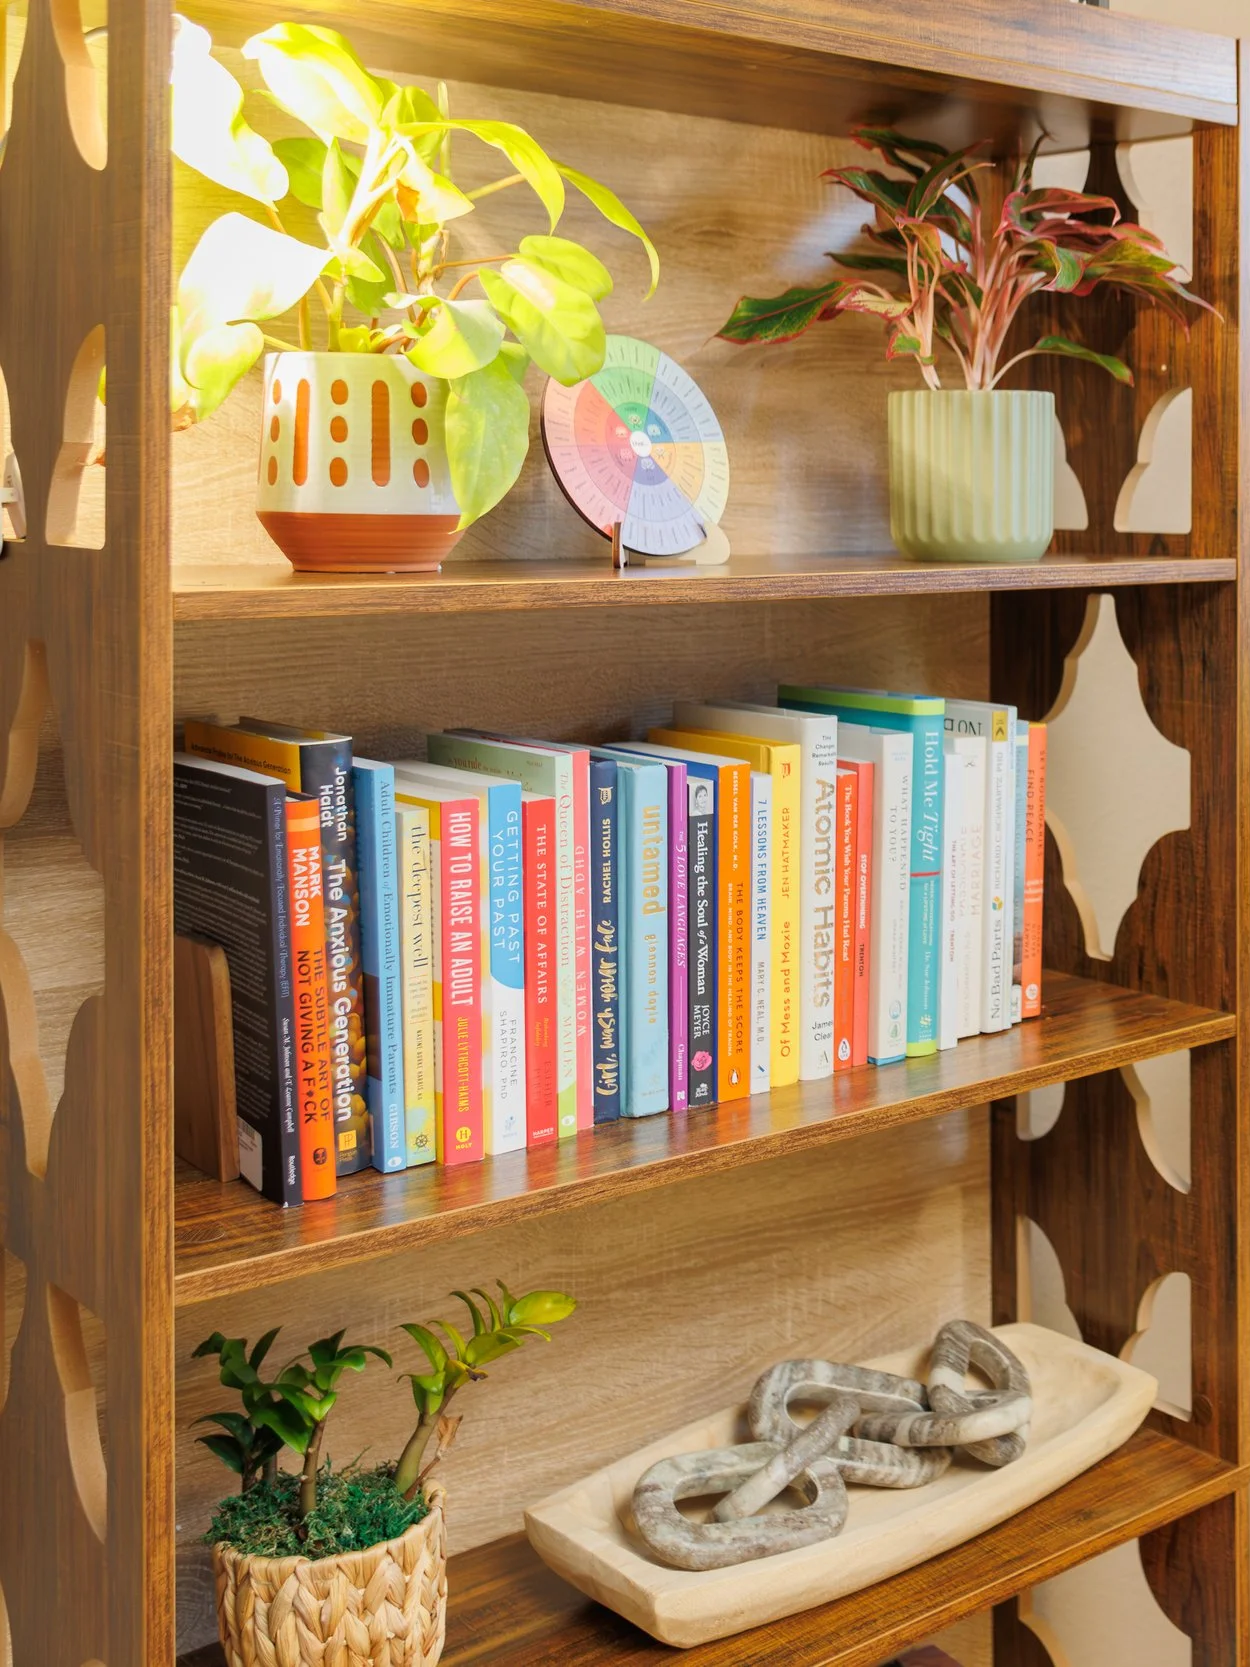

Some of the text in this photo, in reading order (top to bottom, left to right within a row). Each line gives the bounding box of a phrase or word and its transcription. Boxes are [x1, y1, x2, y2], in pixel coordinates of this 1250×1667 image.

[233, 752, 292, 775] The Generation
[560, 772, 569, 789] The
[319, 784, 335, 828] Haidt
[335, 767, 349, 842] Jonathan
[844, 784, 852, 802] The
[844, 804, 852, 826] Book
[900, 775, 908, 812] WHAT
[917, 732, 939, 862] Hold Me Tight
[1026, 769, 1035, 843] FIND PEACE
[411, 826, 427, 855] the
[559, 794, 571, 848] Queen
[757, 810, 767, 859] LESSONS
[889, 806, 897, 862] TO YOU?
[274, 843, 286, 883] Emotionally
[308, 846, 321, 898] MARK
[560, 854, 572, 869] of
[602, 818, 611, 903] RACHEL HOLLIS
[642, 804, 666, 916] untamed
[694, 822, 709, 874] Healing
[781, 807, 790, 899] JEN HATMAKER
[843, 844, 851, 865] Wish
[900, 820, 908, 890] HAPPENED
[970, 824, 981, 916] MARRIAGE
[276, 884, 287, 913] Focused
[292, 848, 310, 927] MANSON
[407, 861, 427, 926] deepest
[492, 830, 505, 949] YOUR PAST
[506, 811, 520, 963] GETTING PAST
[697, 878, 709, 897] the
[757, 863, 767, 894] FROM
[813, 778, 835, 1008] Atomic Habits
[843, 867, 851, 886] Your
[859, 875, 867, 929] OVERTHINKING
[448, 811, 473, 1006] HOW TO RAISE AN ADULT
[536, 824, 548, 1004] THE STATE OF AFFAIRS
[560, 875, 572, 967] Distraction
[676, 844, 687, 968] 5 LOVE LANGUAGES
[697, 899, 709, 928] Soul
[757, 898, 767, 940] HEAVEN
[278, 915, 288, 949] Individual
[380, 781, 398, 1094] Adult Children Emotionally Immature Parents
[413, 933, 429, 968] well
[575, 846, 587, 1036] WOMEN WITH ADHD
[697, 929, 708, 940] of
[842, 940, 850, 961] Read
[278, 950, 289, 979] Therapy
[297, 950, 312, 986] NOT
[644, 934, 659, 1024] glennon doyle
[697, 944, 709, 995] Woman
[736, 882, 744, 1054] THE BODY KEEPS THE SCORE
[757, 961, 765, 984] MARY
[780, 921, 791, 1057] Of Mess and Moxie
[991, 919, 1001, 1020] No Bad Parts
[327, 859, 355, 1122] The Anxious Generation
[594, 919, 618, 1096] Girl, wash your face
[300, 993, 314, 1054] GIVING
[313, 946, 330, 1121] THE SUBTLE ART OF
[693, 1005, 702, 1039] MEYER
[701, 1005, 710, 1035] JOYCE
[727, 1019, 733, 1027] OF
[284, 1068, 293, 1079] and
[302, 1060, 314, 1072] A
[457, 1017, 469, 1113] JULIE LYTHCOTT-HAIMS
[509, 1019, 518, 1087] FRANCINE
[677, 1044, 685, 1081] Chapman
[388, 1103, 399, 1149] GIBSON
[455, 1142, 473, 1151] HOLT
[533, 1127, 554, 1137] HARPER
[288, 1155, 296, 1185] Routledge
